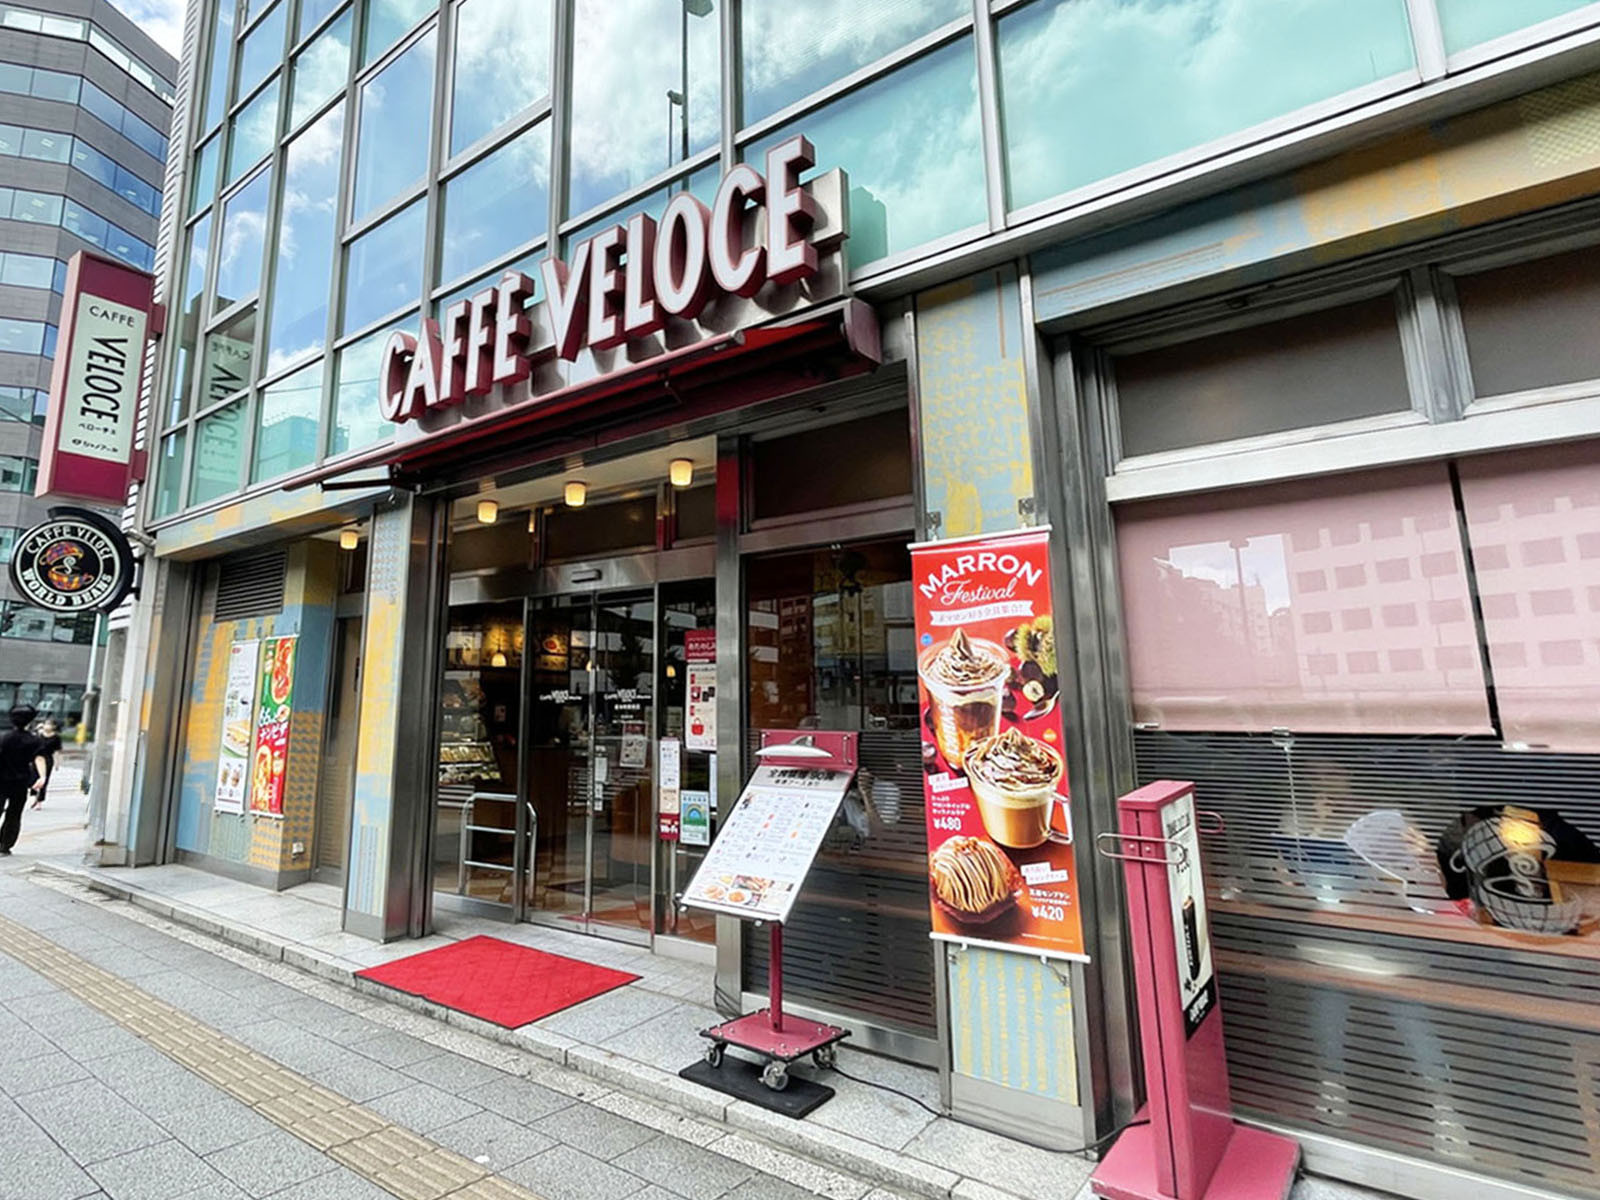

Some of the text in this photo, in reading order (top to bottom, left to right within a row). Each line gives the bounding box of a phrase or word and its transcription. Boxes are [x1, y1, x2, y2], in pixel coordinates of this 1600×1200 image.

[540, 135, 818, 362] VELOCE
[80, 337, 129, 424] VELOCE
[22, 567, 112, 606] WORLD BEANS
[919, 552, 1043, 599] MARRON
[940, 576, 1018, 605] Festival
[1031, 904, 1064, 922] ¥420
